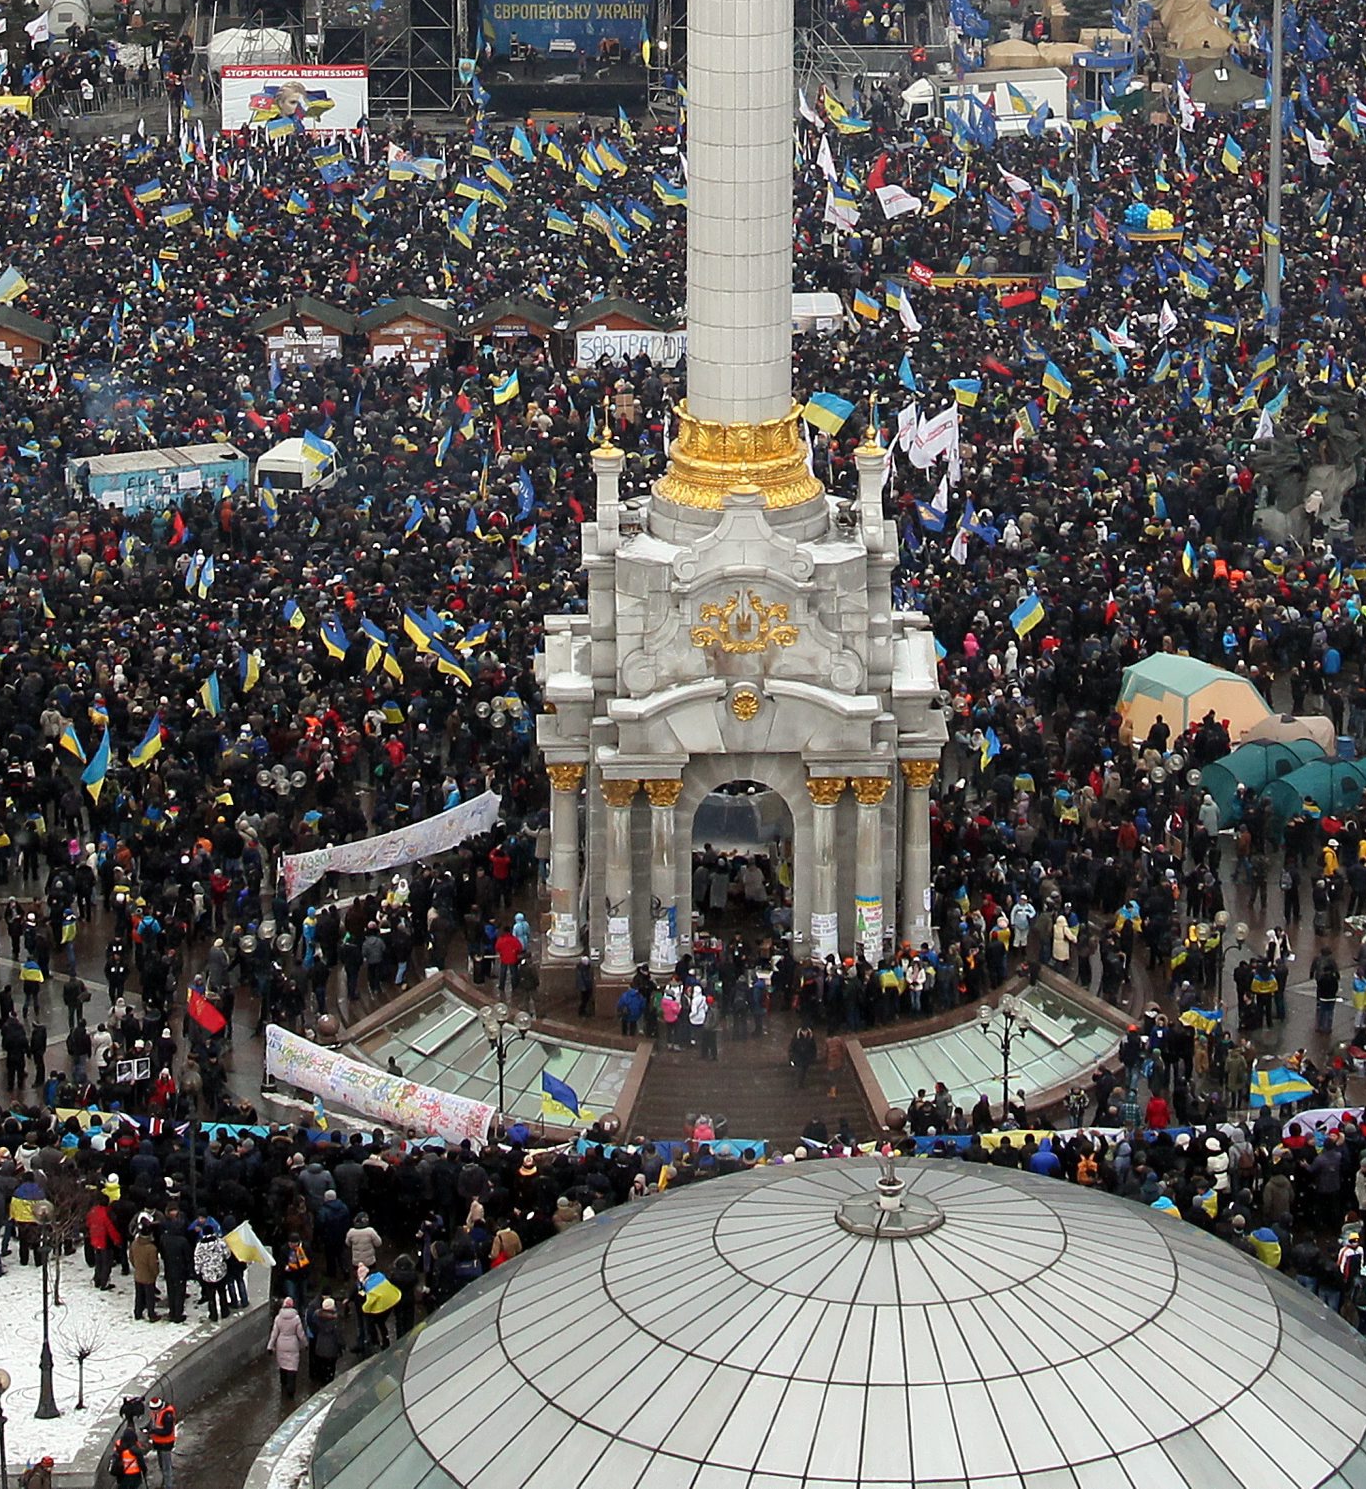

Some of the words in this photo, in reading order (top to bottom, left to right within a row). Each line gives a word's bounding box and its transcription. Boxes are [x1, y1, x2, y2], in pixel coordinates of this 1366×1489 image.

[493, 0, 592, 20] ЄВРОПЕЙСЬКУ
[595, 0, 650, 20] УКРАЇНУ
[225, 69, 250, 77] STOP
[251, 69, 299, 77] POLITICAL
[301, 69, 364, 77] REPRESSIONS
